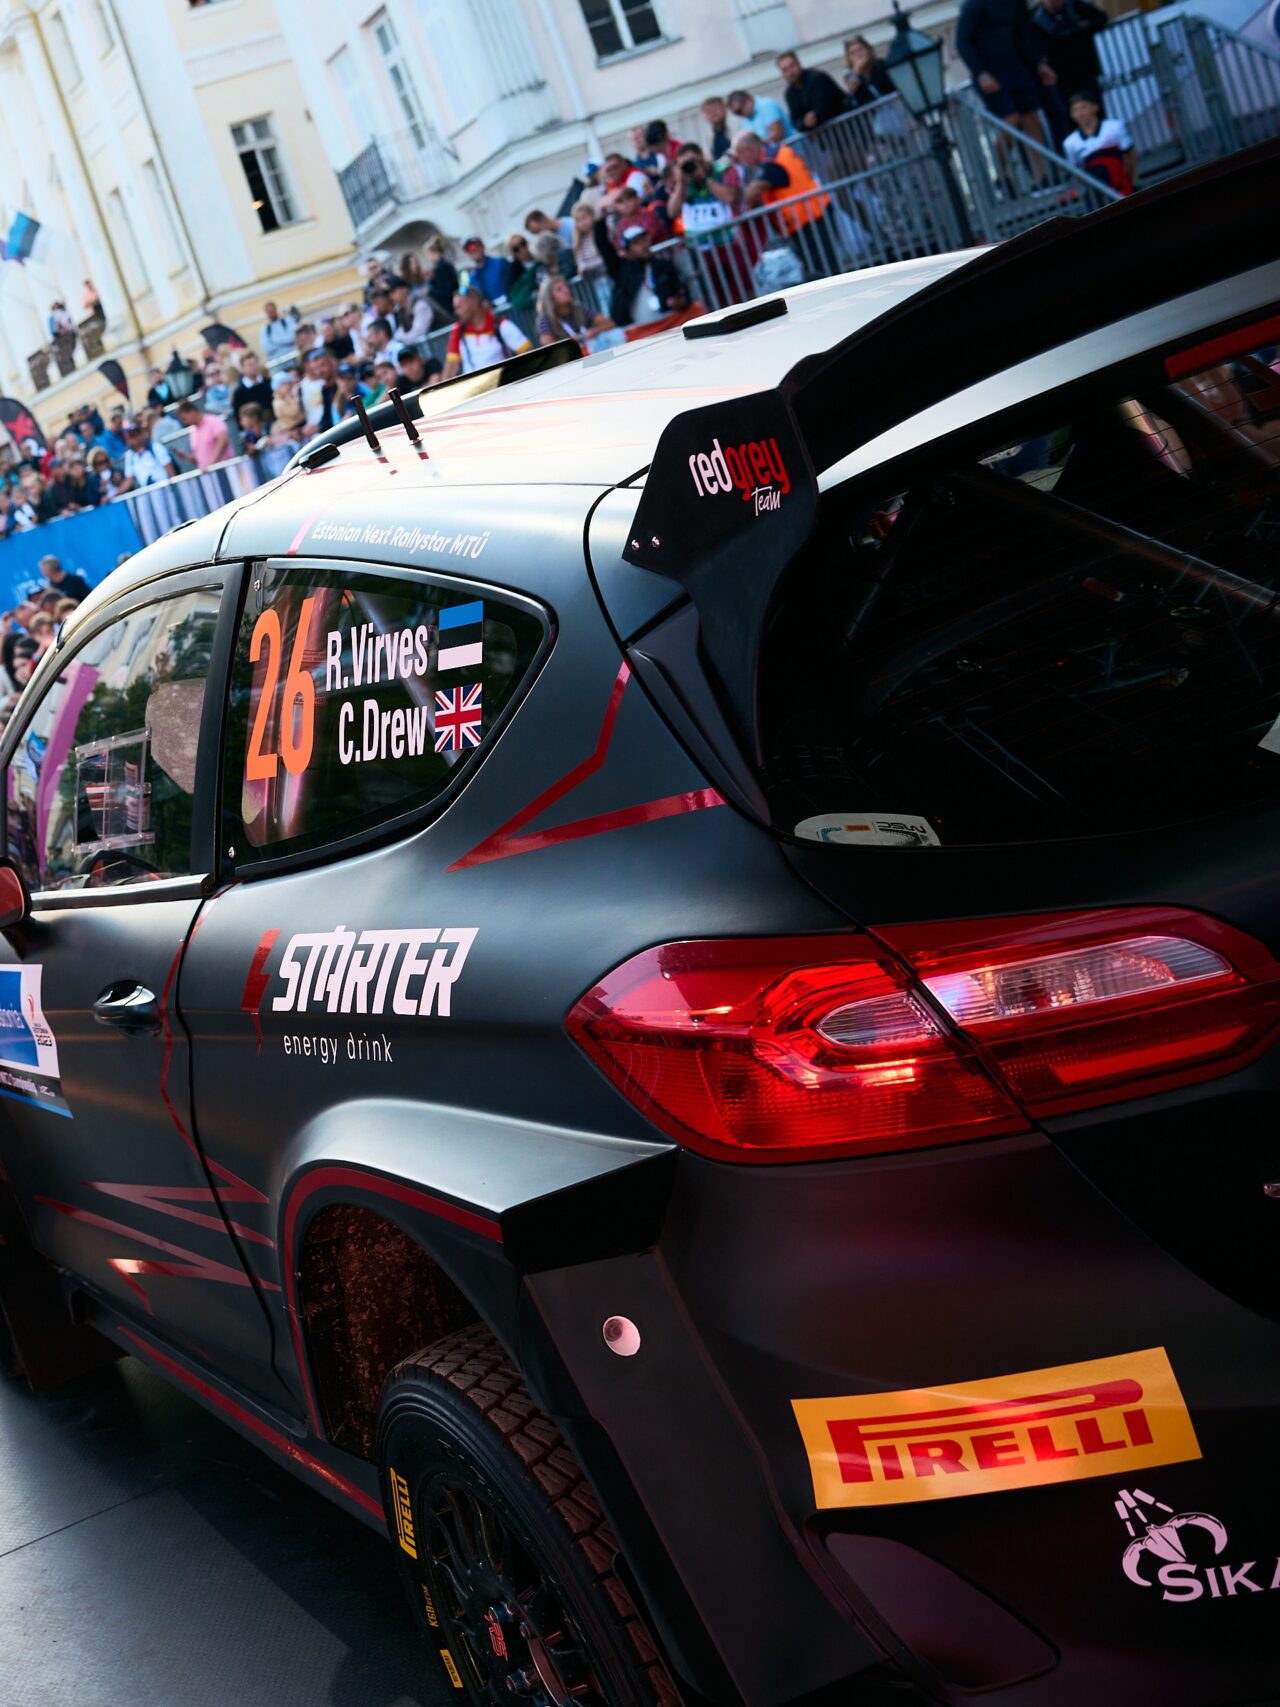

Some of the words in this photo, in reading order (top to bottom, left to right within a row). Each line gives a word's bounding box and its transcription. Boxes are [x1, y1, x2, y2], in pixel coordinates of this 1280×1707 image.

[688, 438, 791, 501] redgrey
[312, 521, 363, 542] Estonian
[360, 524, 392, 546] Next
[390, 526, 452, 554] Rallystar
[449, 530, 491, 559] MTÜ
[246, 597, 316, 782] 26
[325, 622, 428, 691] R.Virves
[339, 699, 427, 765] C.Drew
[272, 925, 479, 1017] STARTER
[283, 1034, 338, 1065] energy
[347, 1032, 393, 1063] drink
[826, 1378, 1154, 1483] PIRELLI
[390, 1467, 417, 1560] PIRELLI
